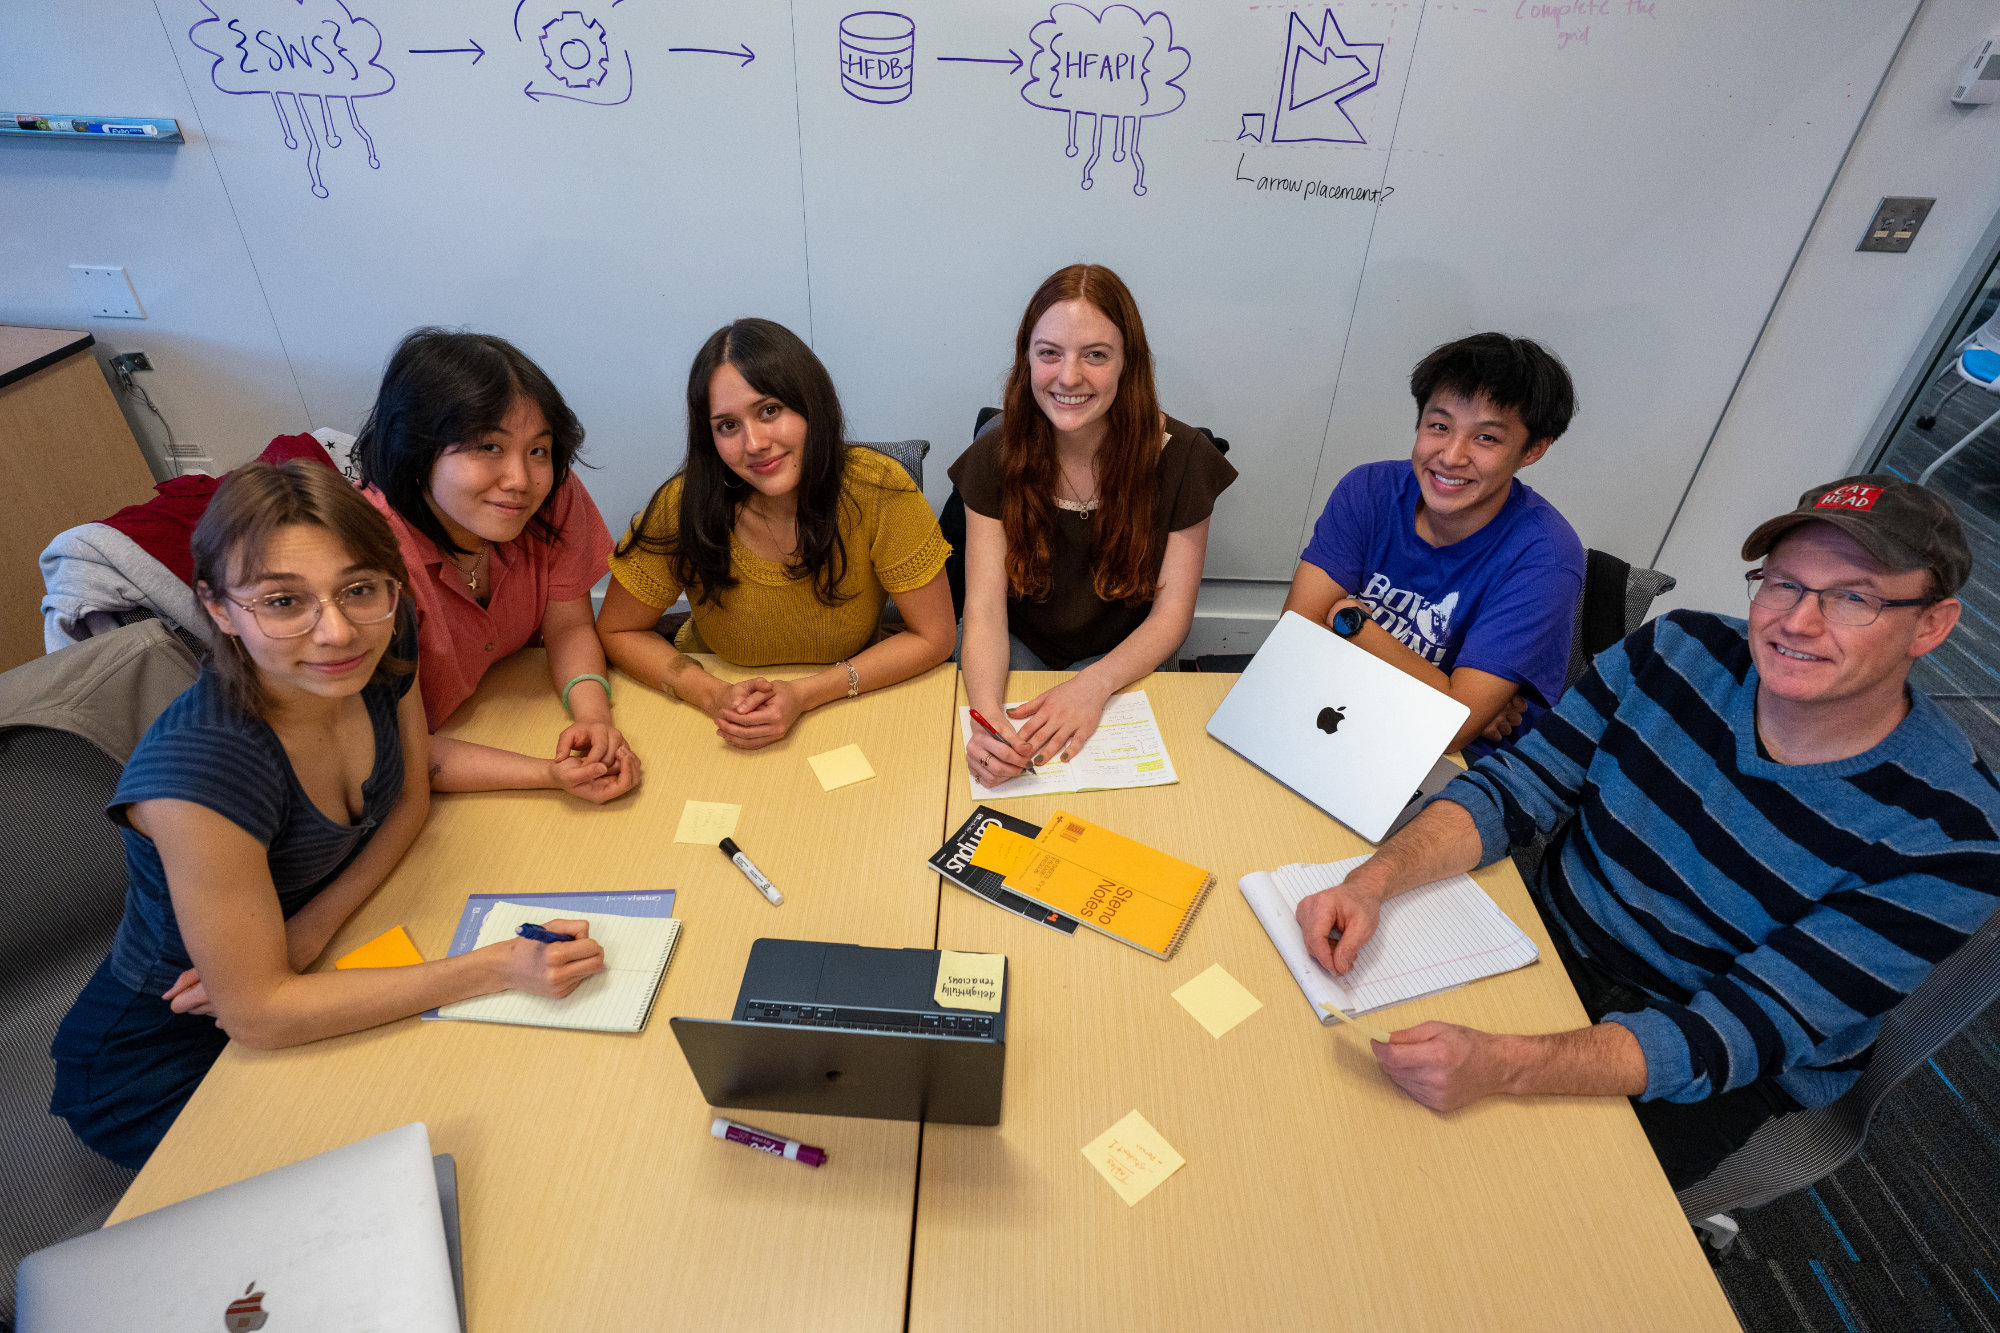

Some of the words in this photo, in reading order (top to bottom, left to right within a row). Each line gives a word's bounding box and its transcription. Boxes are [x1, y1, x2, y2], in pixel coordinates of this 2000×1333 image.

[1256, 176, 1303, 192] arrow
[1303, 180, 1395, 206] placement?
[1821, 495, 1869, 507] HEAD
[1833, 485, 1878, 497] CAT
[1080, 879, 1117, 918] Notes
[1098, 886, 1133, 925] Steno
[941, 982, 996, 1001] delightfully
